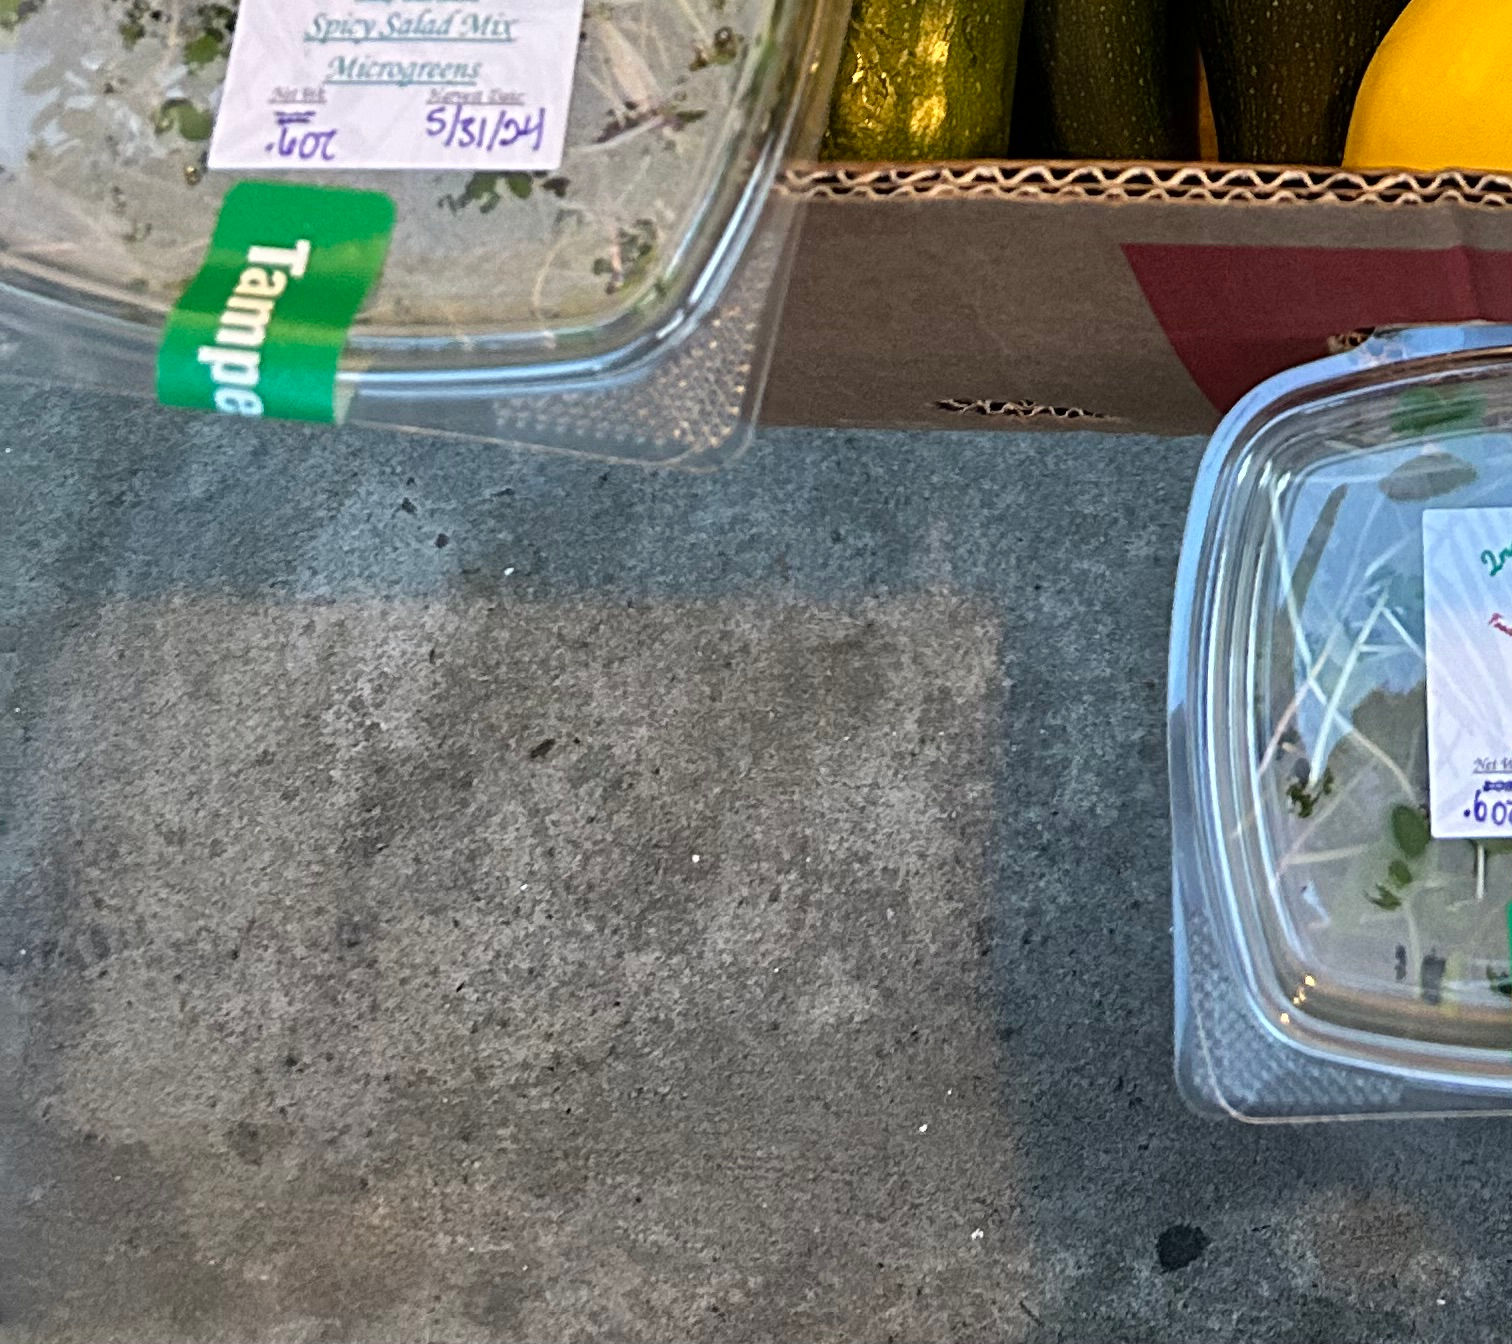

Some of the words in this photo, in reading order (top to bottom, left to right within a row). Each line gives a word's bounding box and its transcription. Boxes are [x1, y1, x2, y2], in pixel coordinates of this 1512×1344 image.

[306, 12, 376, 44] Spicy
[379, 8, 462, 38] Salad
[461, 12, 518, 40] Mix
[326, 56, 482, 86] Microgreens
[425, 104, 546, 152] 5/31/24
[1473, 756, 1498, 772] Net
